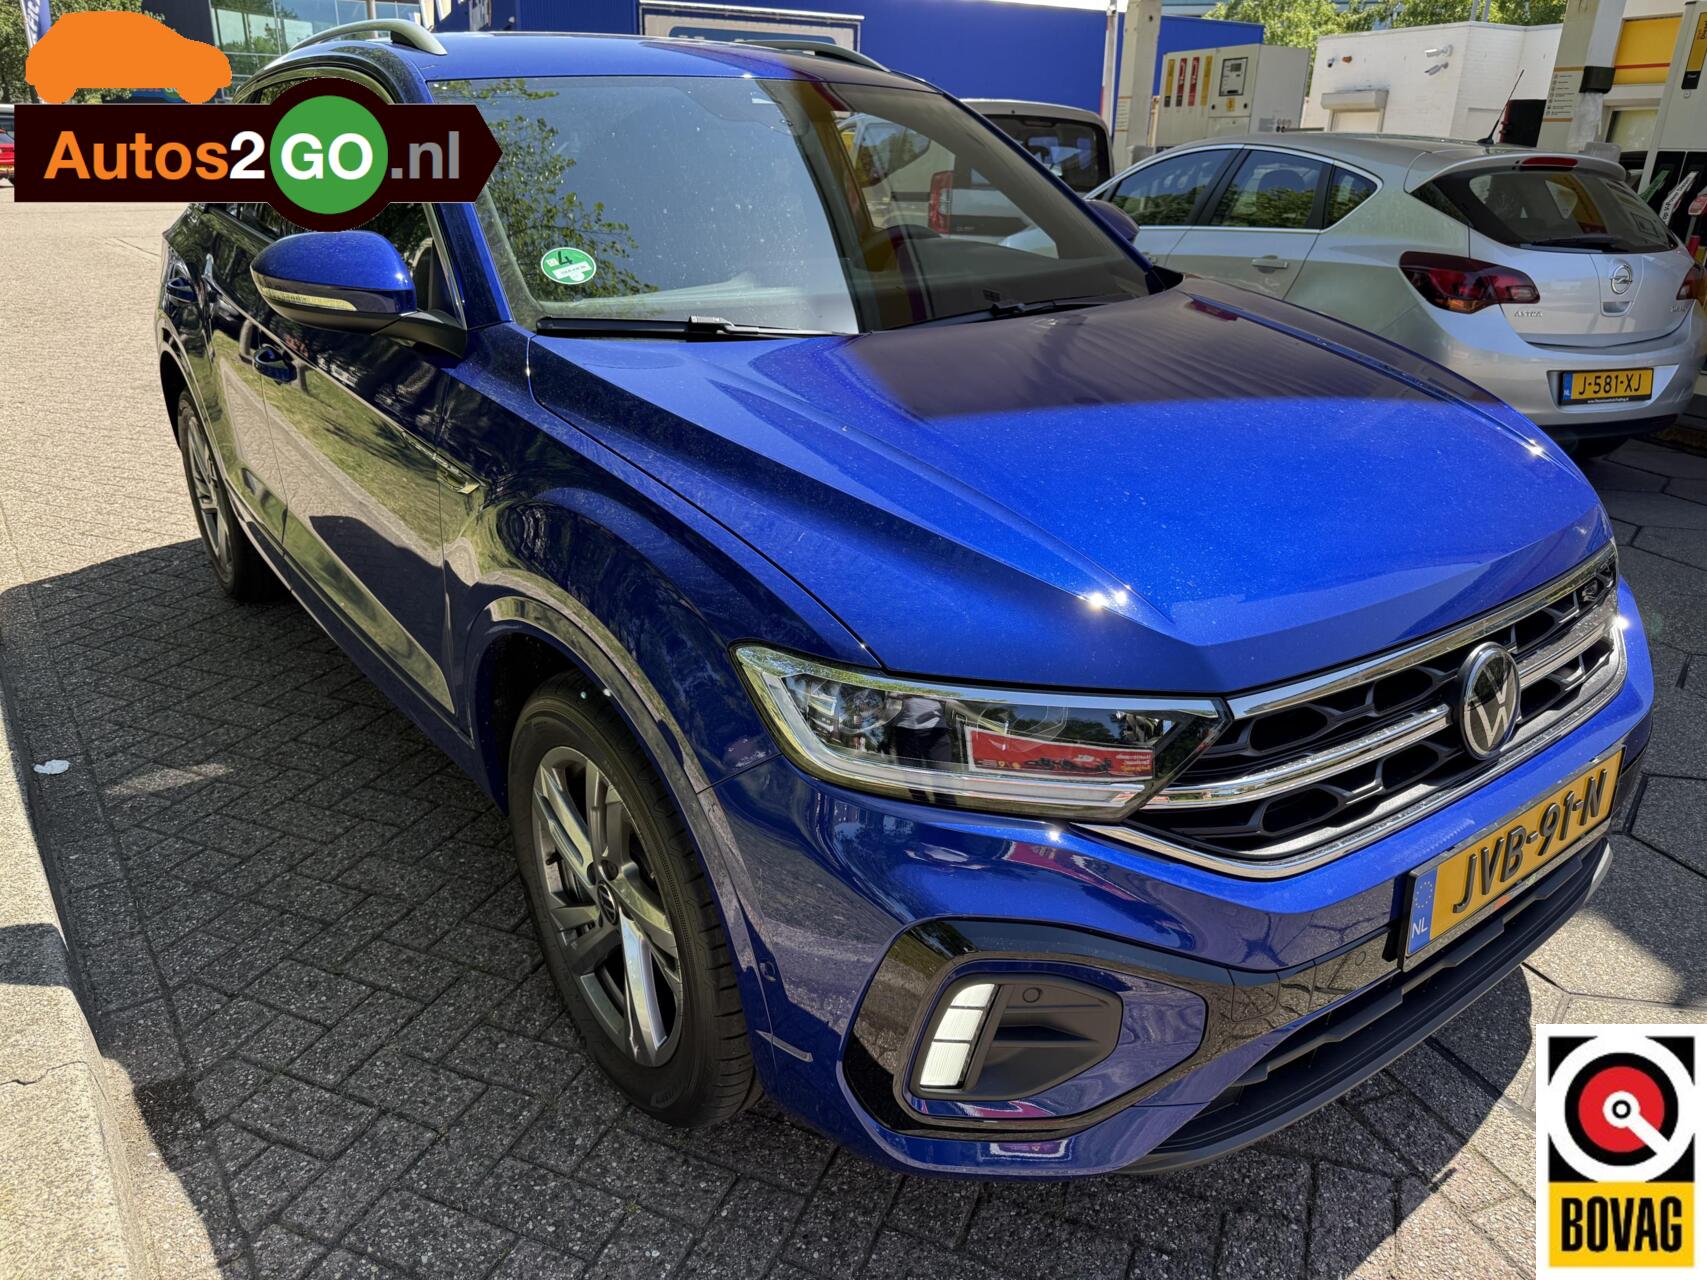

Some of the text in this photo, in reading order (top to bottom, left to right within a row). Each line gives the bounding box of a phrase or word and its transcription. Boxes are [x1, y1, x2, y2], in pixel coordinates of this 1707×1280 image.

[1514, 310, 1543, 318] ASTRA
[1579, 373, 1642, 395] J-581-XJ
[1411, 768, 1608, 939] NL JVB-91-N
